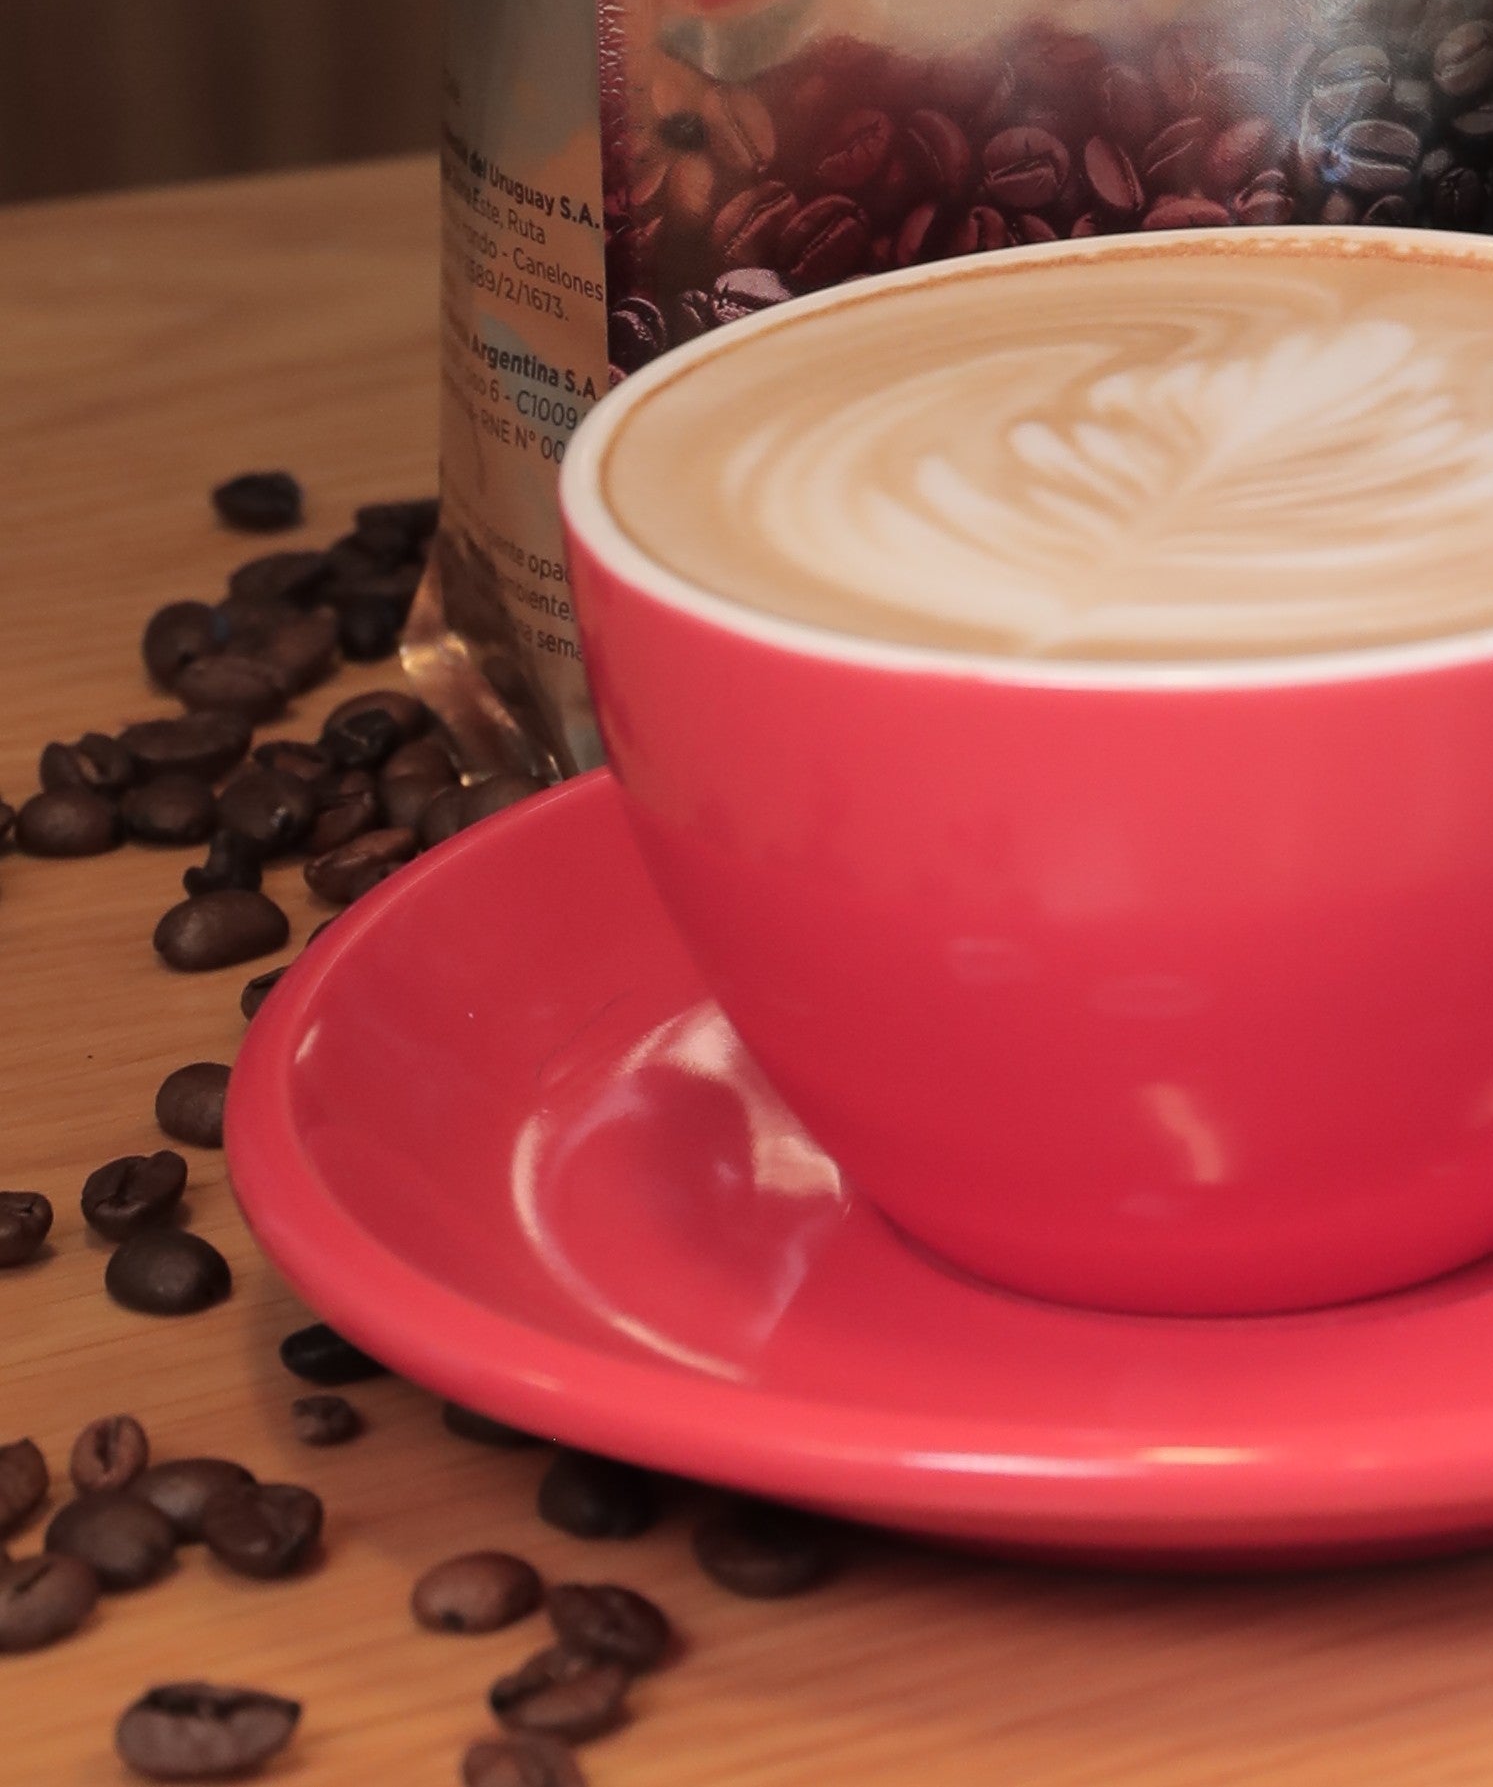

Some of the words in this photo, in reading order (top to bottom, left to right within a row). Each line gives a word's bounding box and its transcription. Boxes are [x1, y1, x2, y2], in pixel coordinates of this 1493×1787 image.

[489, 163, 556, 216] Uruguay
[560, 196, 601, 229] S.A.
[507, 207, 547, 245] Ruta
[513, 246, 605, 302] Canelones
[471, 334, 559, 387] Argentina
